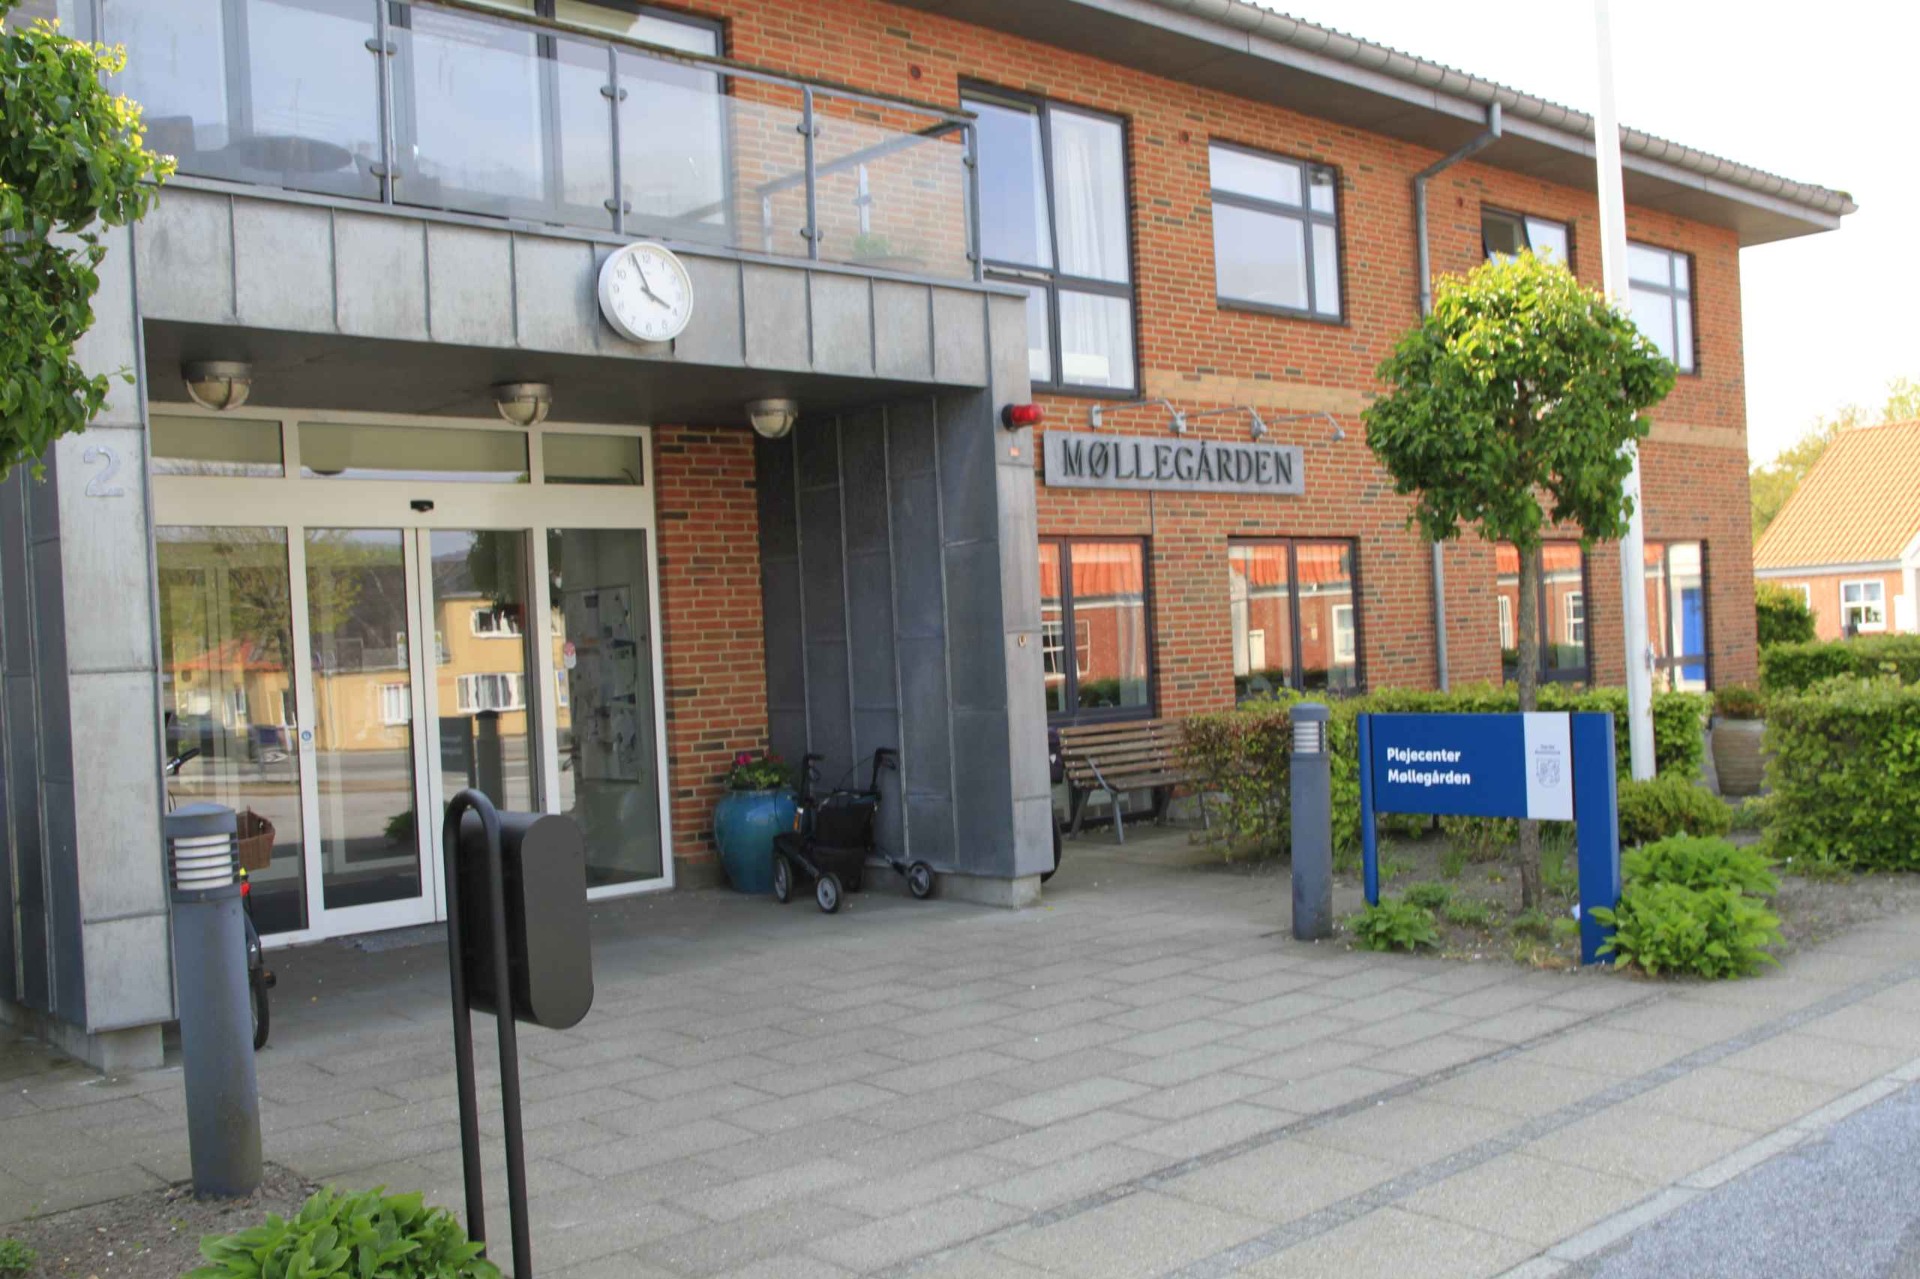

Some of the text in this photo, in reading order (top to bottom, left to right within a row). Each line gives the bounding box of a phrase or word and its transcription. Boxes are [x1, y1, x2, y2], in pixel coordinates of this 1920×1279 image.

[83, 444, 124, 498] 2
[1062, 439, 1293, 485] MØLLEGÅRDEN
[1387, 747, 1461, 764] Plejecenter
[1388, 769, 1471, 787] Møllegården
